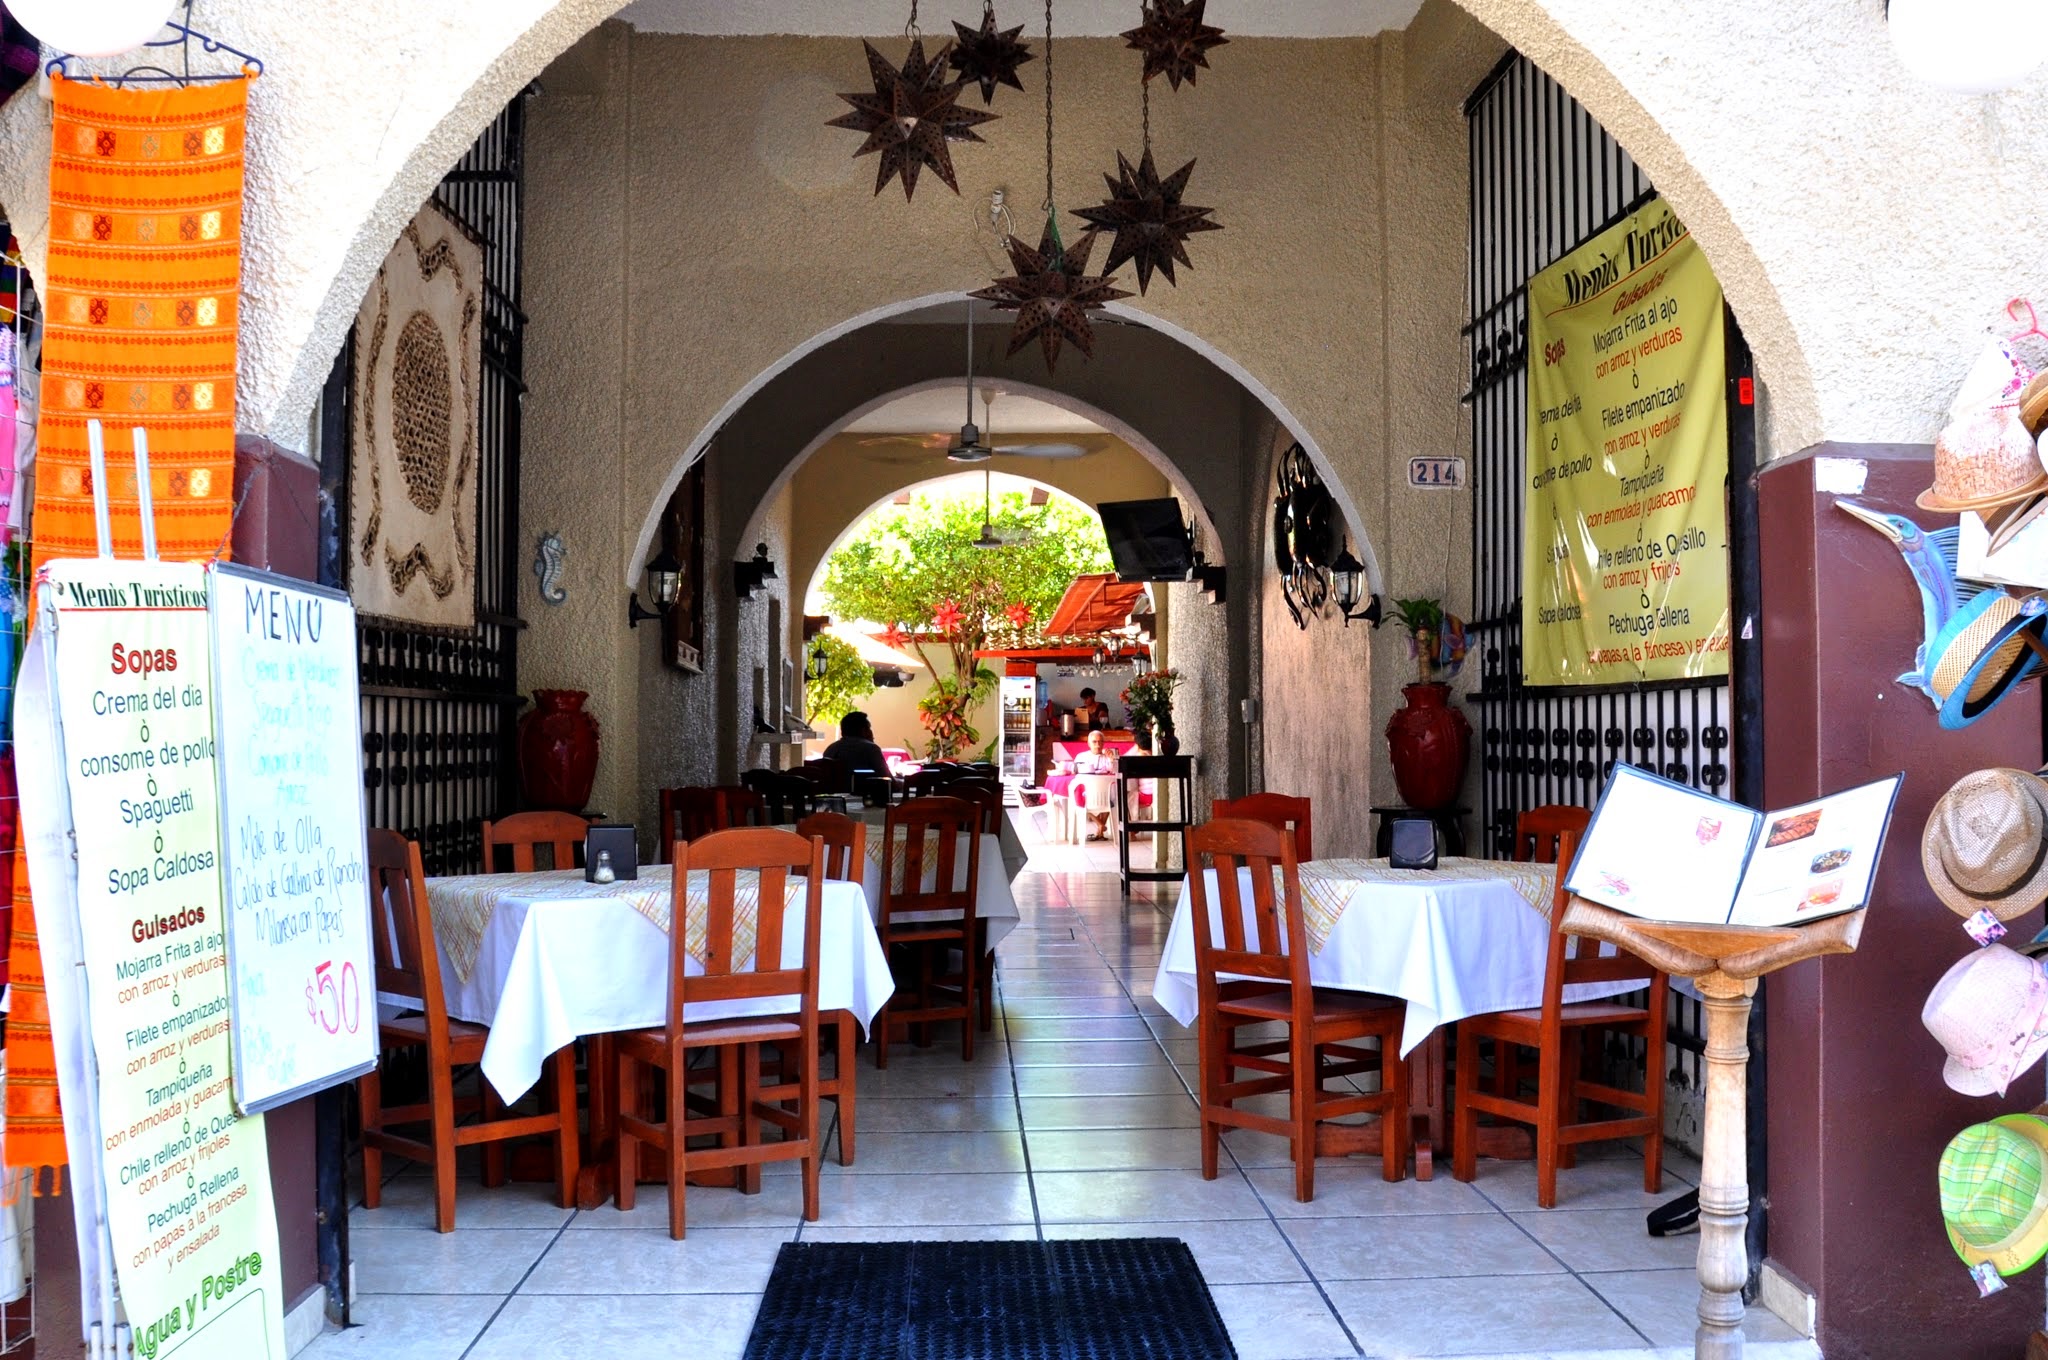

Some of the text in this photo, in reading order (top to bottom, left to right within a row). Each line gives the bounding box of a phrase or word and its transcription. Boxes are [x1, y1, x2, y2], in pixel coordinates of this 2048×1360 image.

[1593, 296, 1678, 354] Mojarra Frita al ajo
[1596, 326, 1683, 379] con arroz y verduras
[1602, 379, 1685, 430] Filete empanizado
[1604, 439, 1618, 456] con
[1619, 431, 1640, 450] arroz
[1641, 428, 1647, 448] y
[1417, 463, 1456, 482] 214
[1570, 454, 1592, 481] pollo
[1587, 511, 1602, 528] con
[1646, 538, 1663, 560] de
[129, 582, 208, 607] Turisticos
[1603, 574, 1618, 589] con
[1619, 569, 1640, 587] arroz
[1642, 568, 1648, 588] y
[245, 584, 322, 645] MENÚ
[1609, 611, 1654, 637] Pechuga
[111, 642, 177, 680] Sopas
[1623, 647, 1629, 661] a
[1631, 642, 1642, 661] la
[1685, 640, 1693, 655] y
[93, 684, 203, 715] Crema del dia
[80, 750, 155, 777] consome
[160, 742, 179, 765] de
[120, 788, 194, 828] Spaguetti
[274, 819, 287, 854] de
[296, 815, 322, 854] Olla
[108, 850, 214, 895] Sopa Caldosa
[266, 868, 277, 898] de
[313, 859, 325, 886] de
[315, 896, 344, 944] Papas
[116, 931, 223, 981] Mojarra Frita al ajo
[118, 954, 226, 1004] con arroz y verduras
[305, 960, 359, 1034] $50
[126, 996, 228, 1050] Filete empanizado
[127, 1019, 230, 1075] con arroz y verduras
[145, 1064, 213, 1106] Tampiqueña
[105, 1076, 233, 1151] con enmolada y guacam
[120, 1110, 239, 1185] Chile relleno de Ques
[138, 1133, 230, 1195] con arroz y frijoles
[148, 1167, 239, 1232] Pechuga Rellena
[133, 1183, 247, 1268] con papas a la francesa
[167, 1224, 220, 1274] y ensalada
[135, 1252, 262, 1360] Agua y Postre
